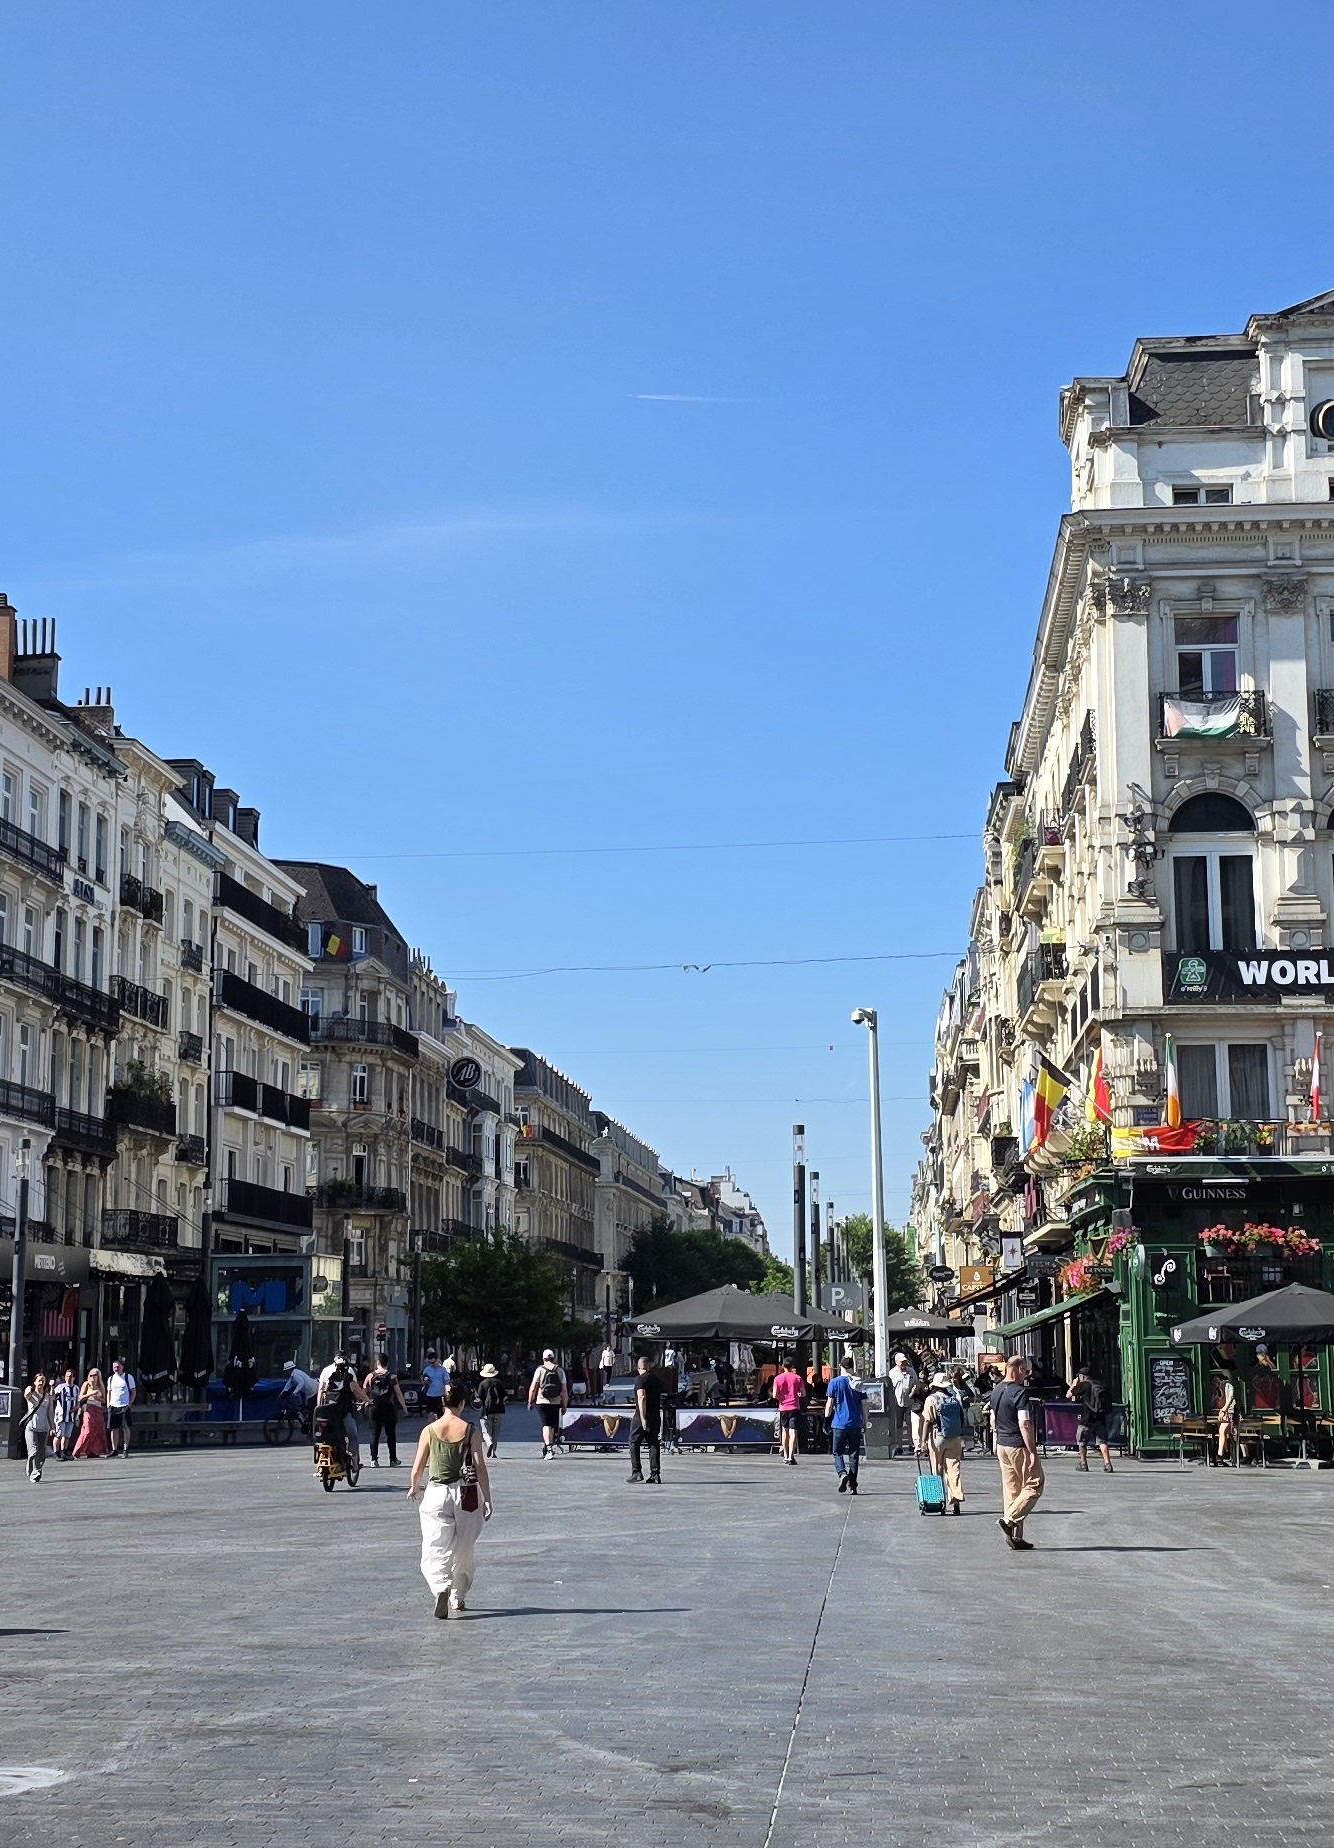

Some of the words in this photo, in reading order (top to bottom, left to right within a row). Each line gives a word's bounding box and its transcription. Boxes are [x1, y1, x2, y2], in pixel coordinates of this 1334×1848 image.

[455, 1064, 475, 1080] AB
[1182, 1187, 1246, 1199] GUINNESS
[34, 1254, 56, 1270] METTEKO
[831, 1287, 845, 1306] P
